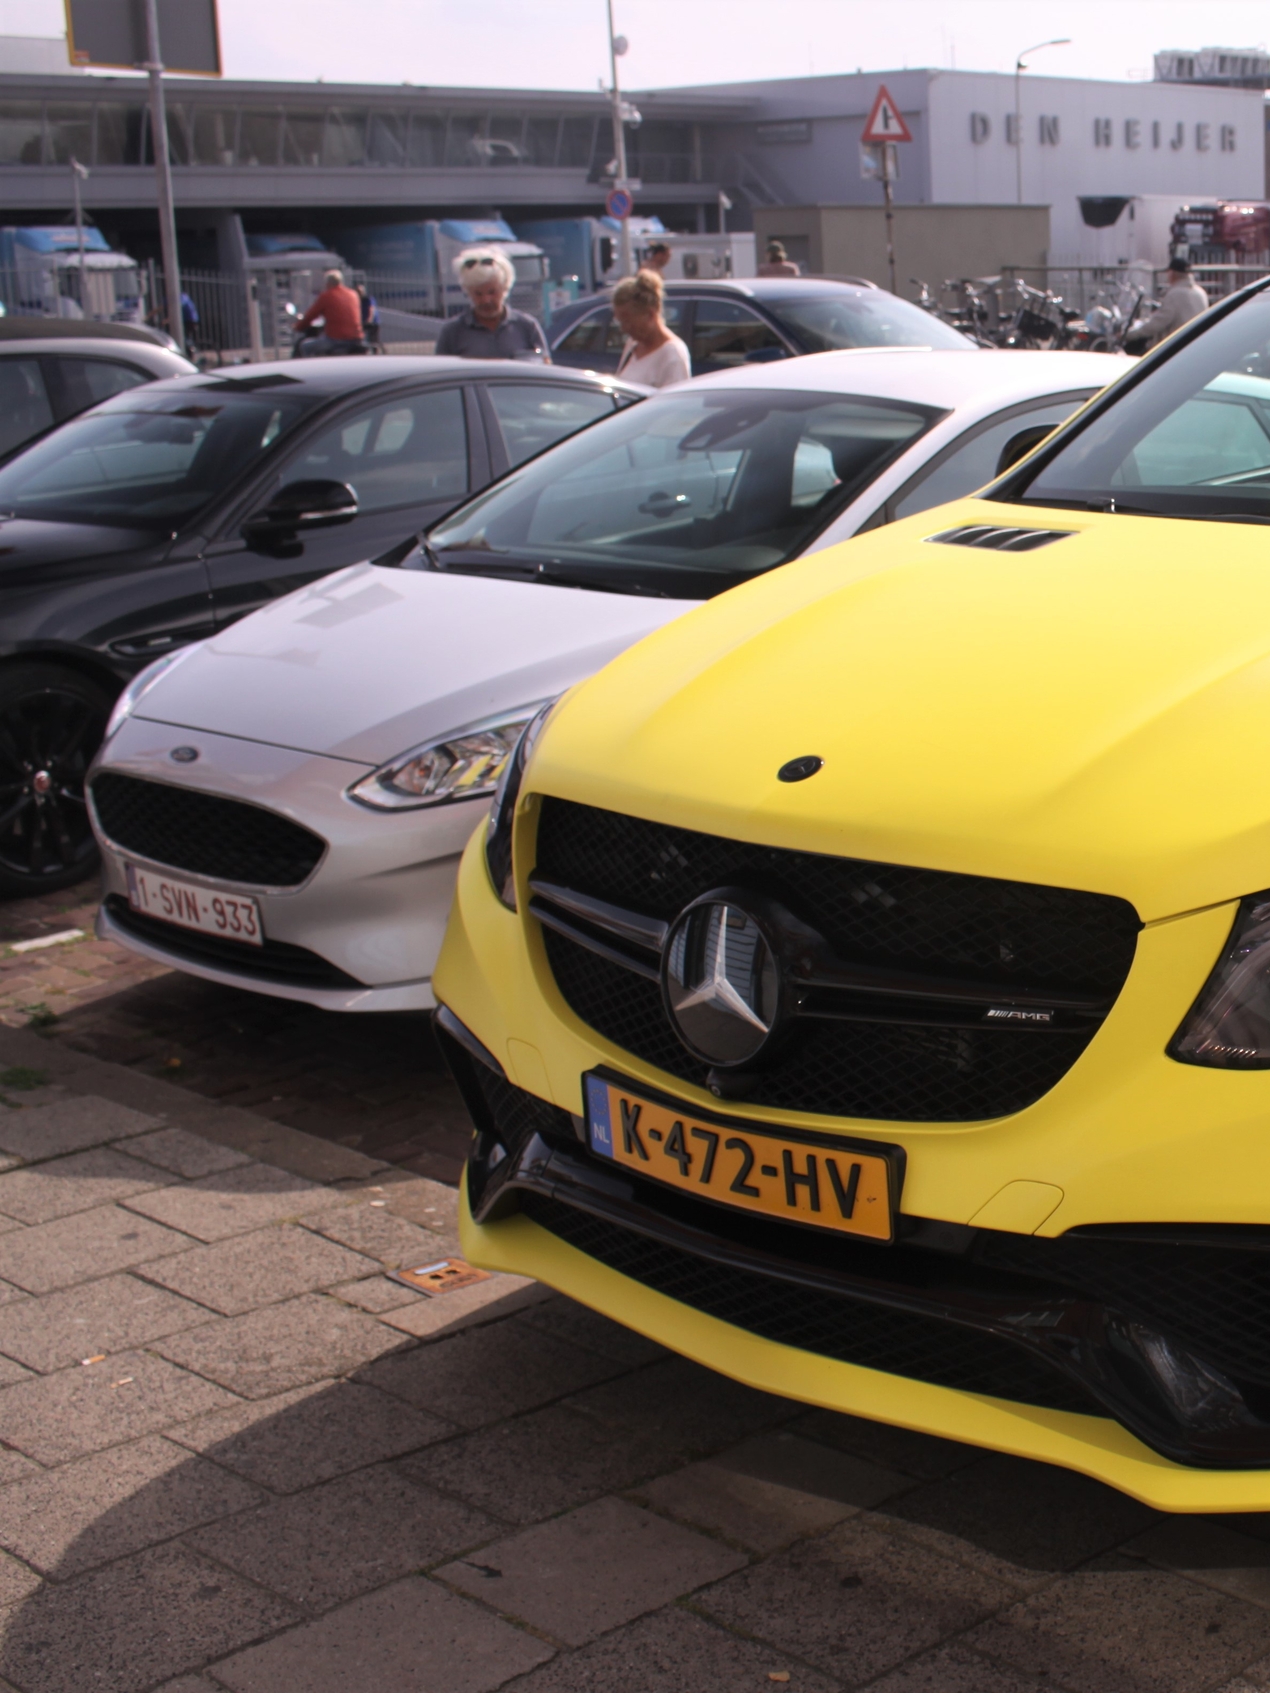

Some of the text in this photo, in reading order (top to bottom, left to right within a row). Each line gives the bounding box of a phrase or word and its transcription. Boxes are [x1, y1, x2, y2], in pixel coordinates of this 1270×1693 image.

[970, 112, 1236, 151] DEN HEIJER
[1007, 1011, 1050, 1021] AMG
[593, 1122, 610, 1144] NL
[619, 1098, 862, 1220] K-472-HV
